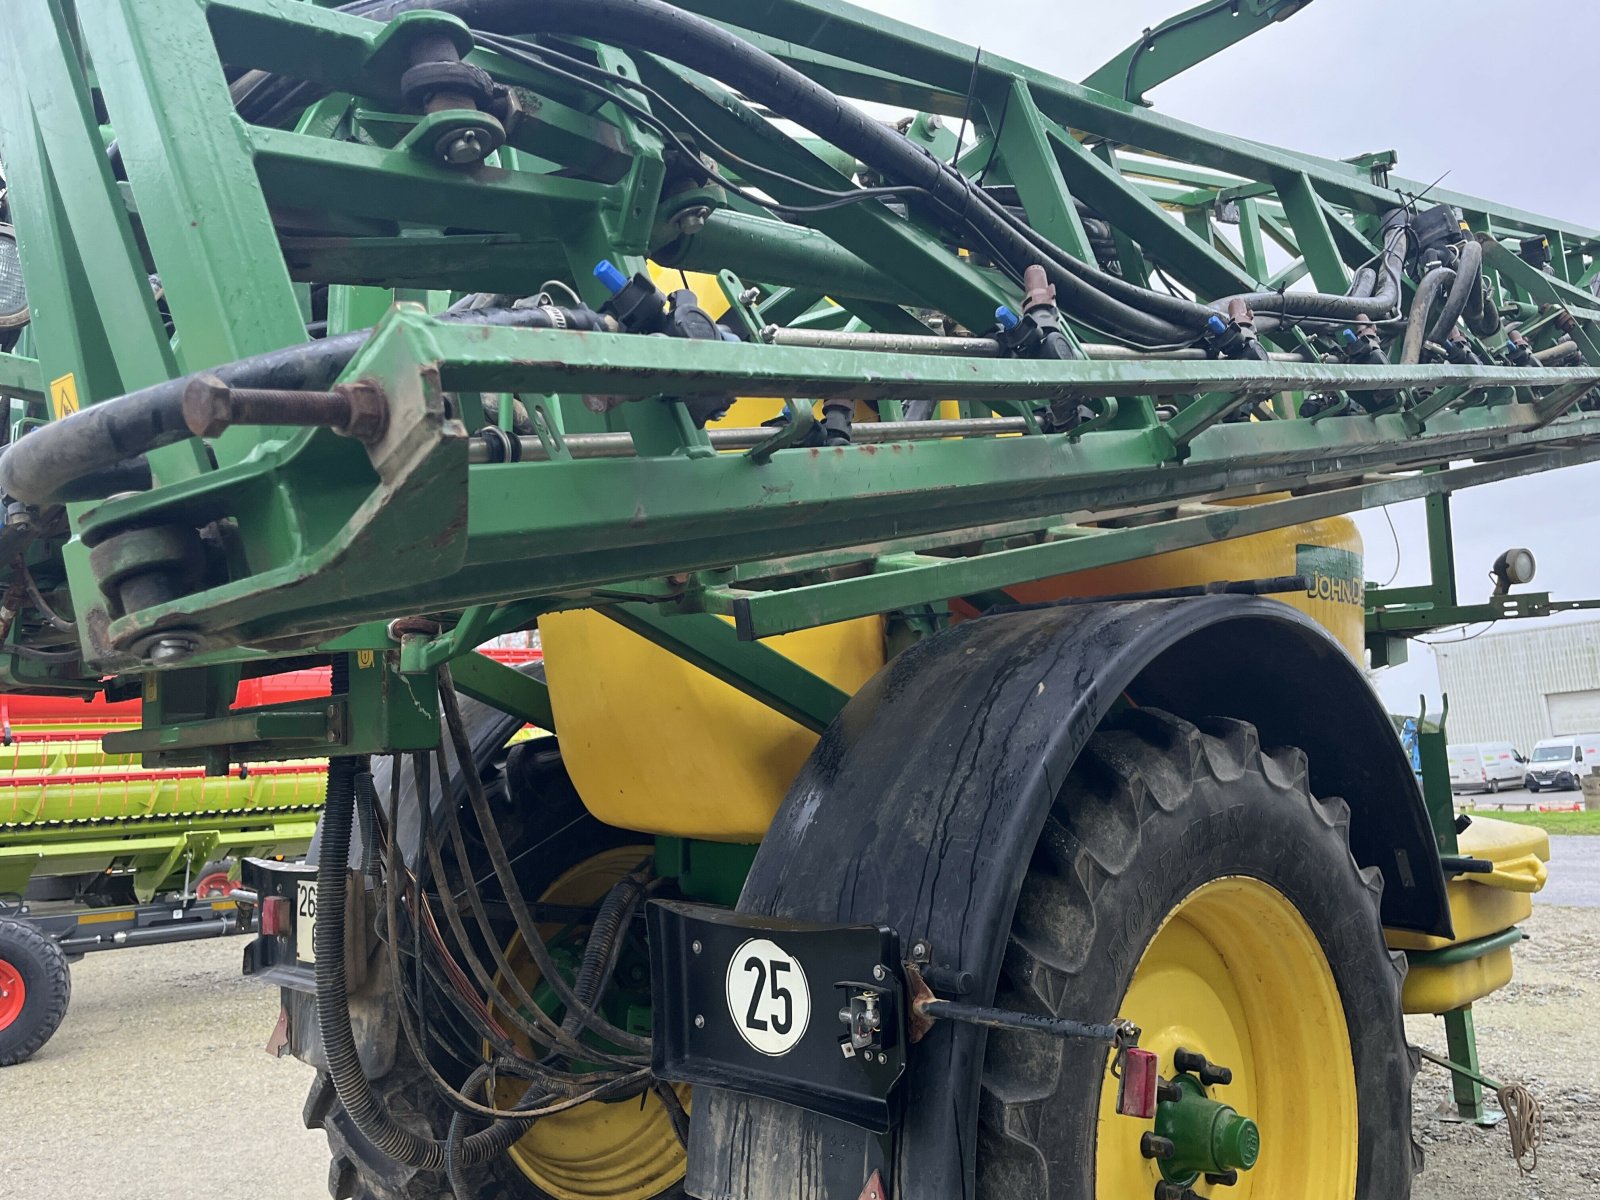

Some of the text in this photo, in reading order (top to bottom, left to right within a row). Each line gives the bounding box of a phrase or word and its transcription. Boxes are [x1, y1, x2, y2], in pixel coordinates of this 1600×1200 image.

[1308, 570, 1350, 603] JOHN
[299, 885, 316, 918] 26
[744, 956, 793, 1035] 25
